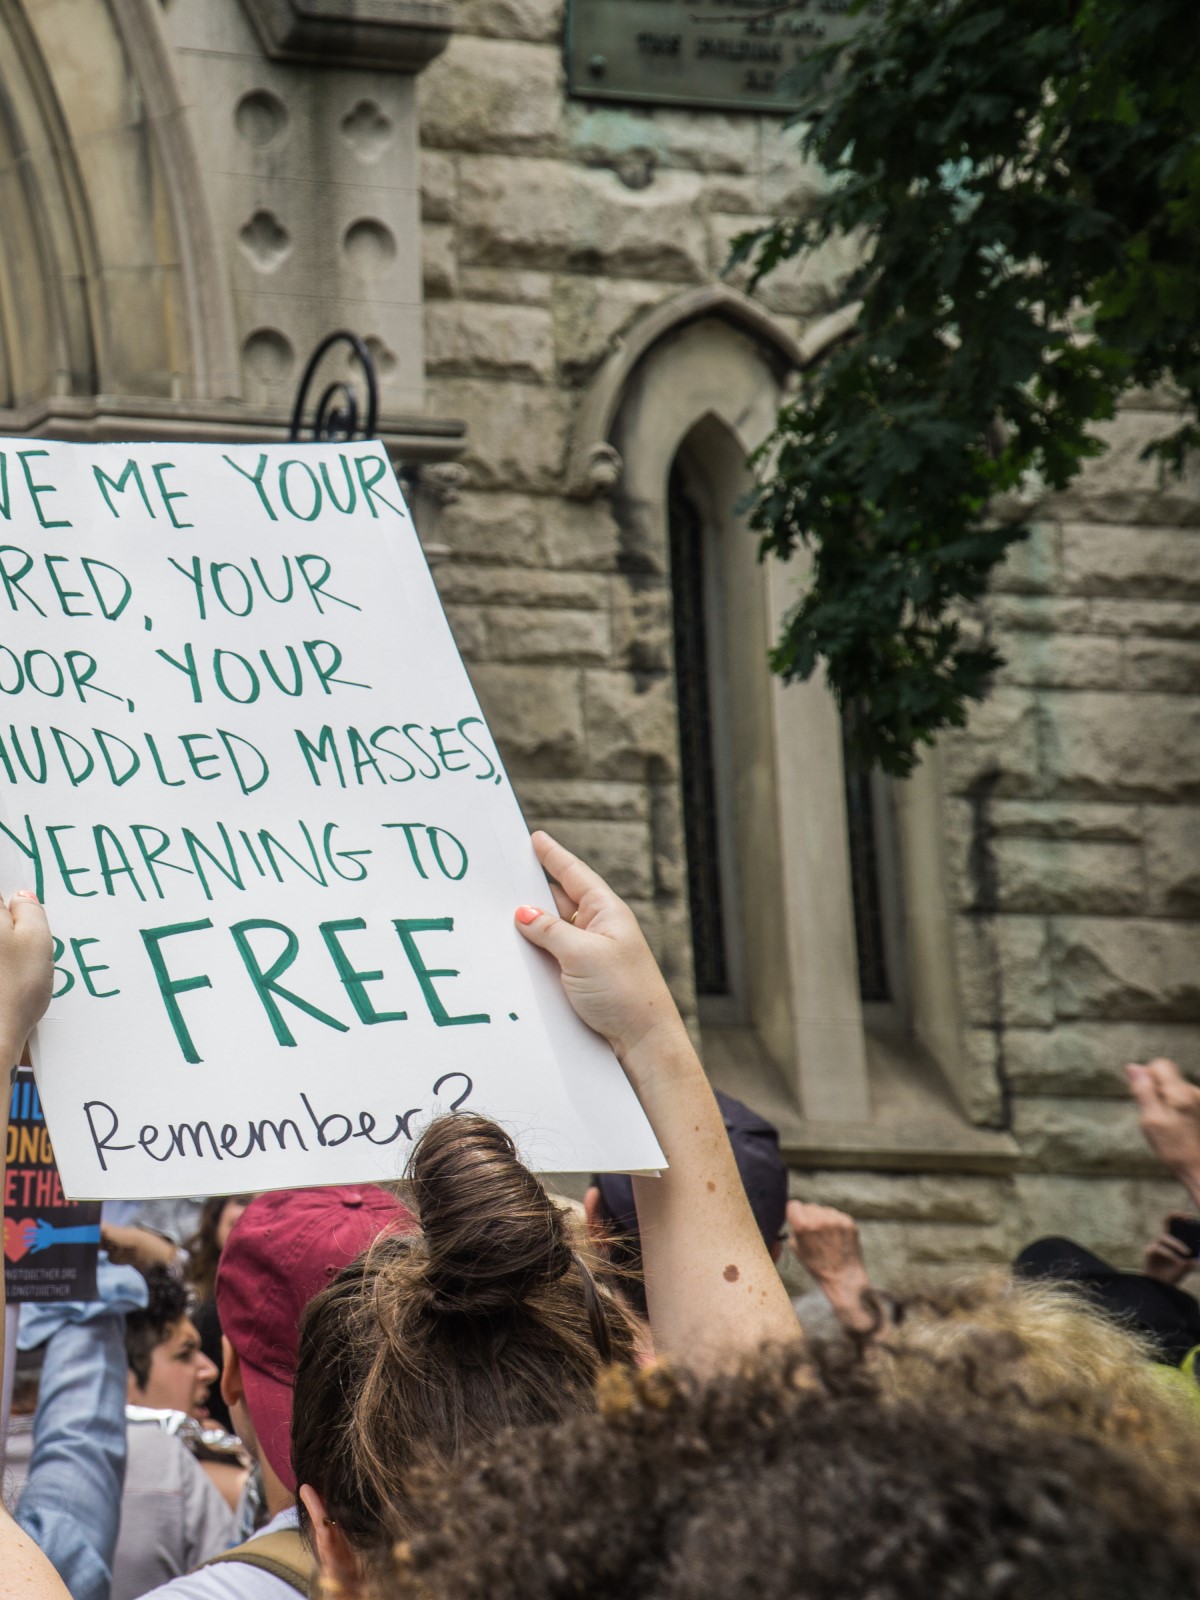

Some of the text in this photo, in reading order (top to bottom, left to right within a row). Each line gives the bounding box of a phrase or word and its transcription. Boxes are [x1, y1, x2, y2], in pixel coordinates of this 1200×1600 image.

[92, 458, 194, 529] ME
[222, 453, 405, 523] YOUR
[167, 553, 362, 620] YOUR
[155, 639, 372, 705] YOUR
[294, 716, 503, 788] MASSES,
[382, 822, 470, 881] TO
[52, 916, 520, 1065] BE FREE.
[83, 1070, 474, 1171] Remember?
